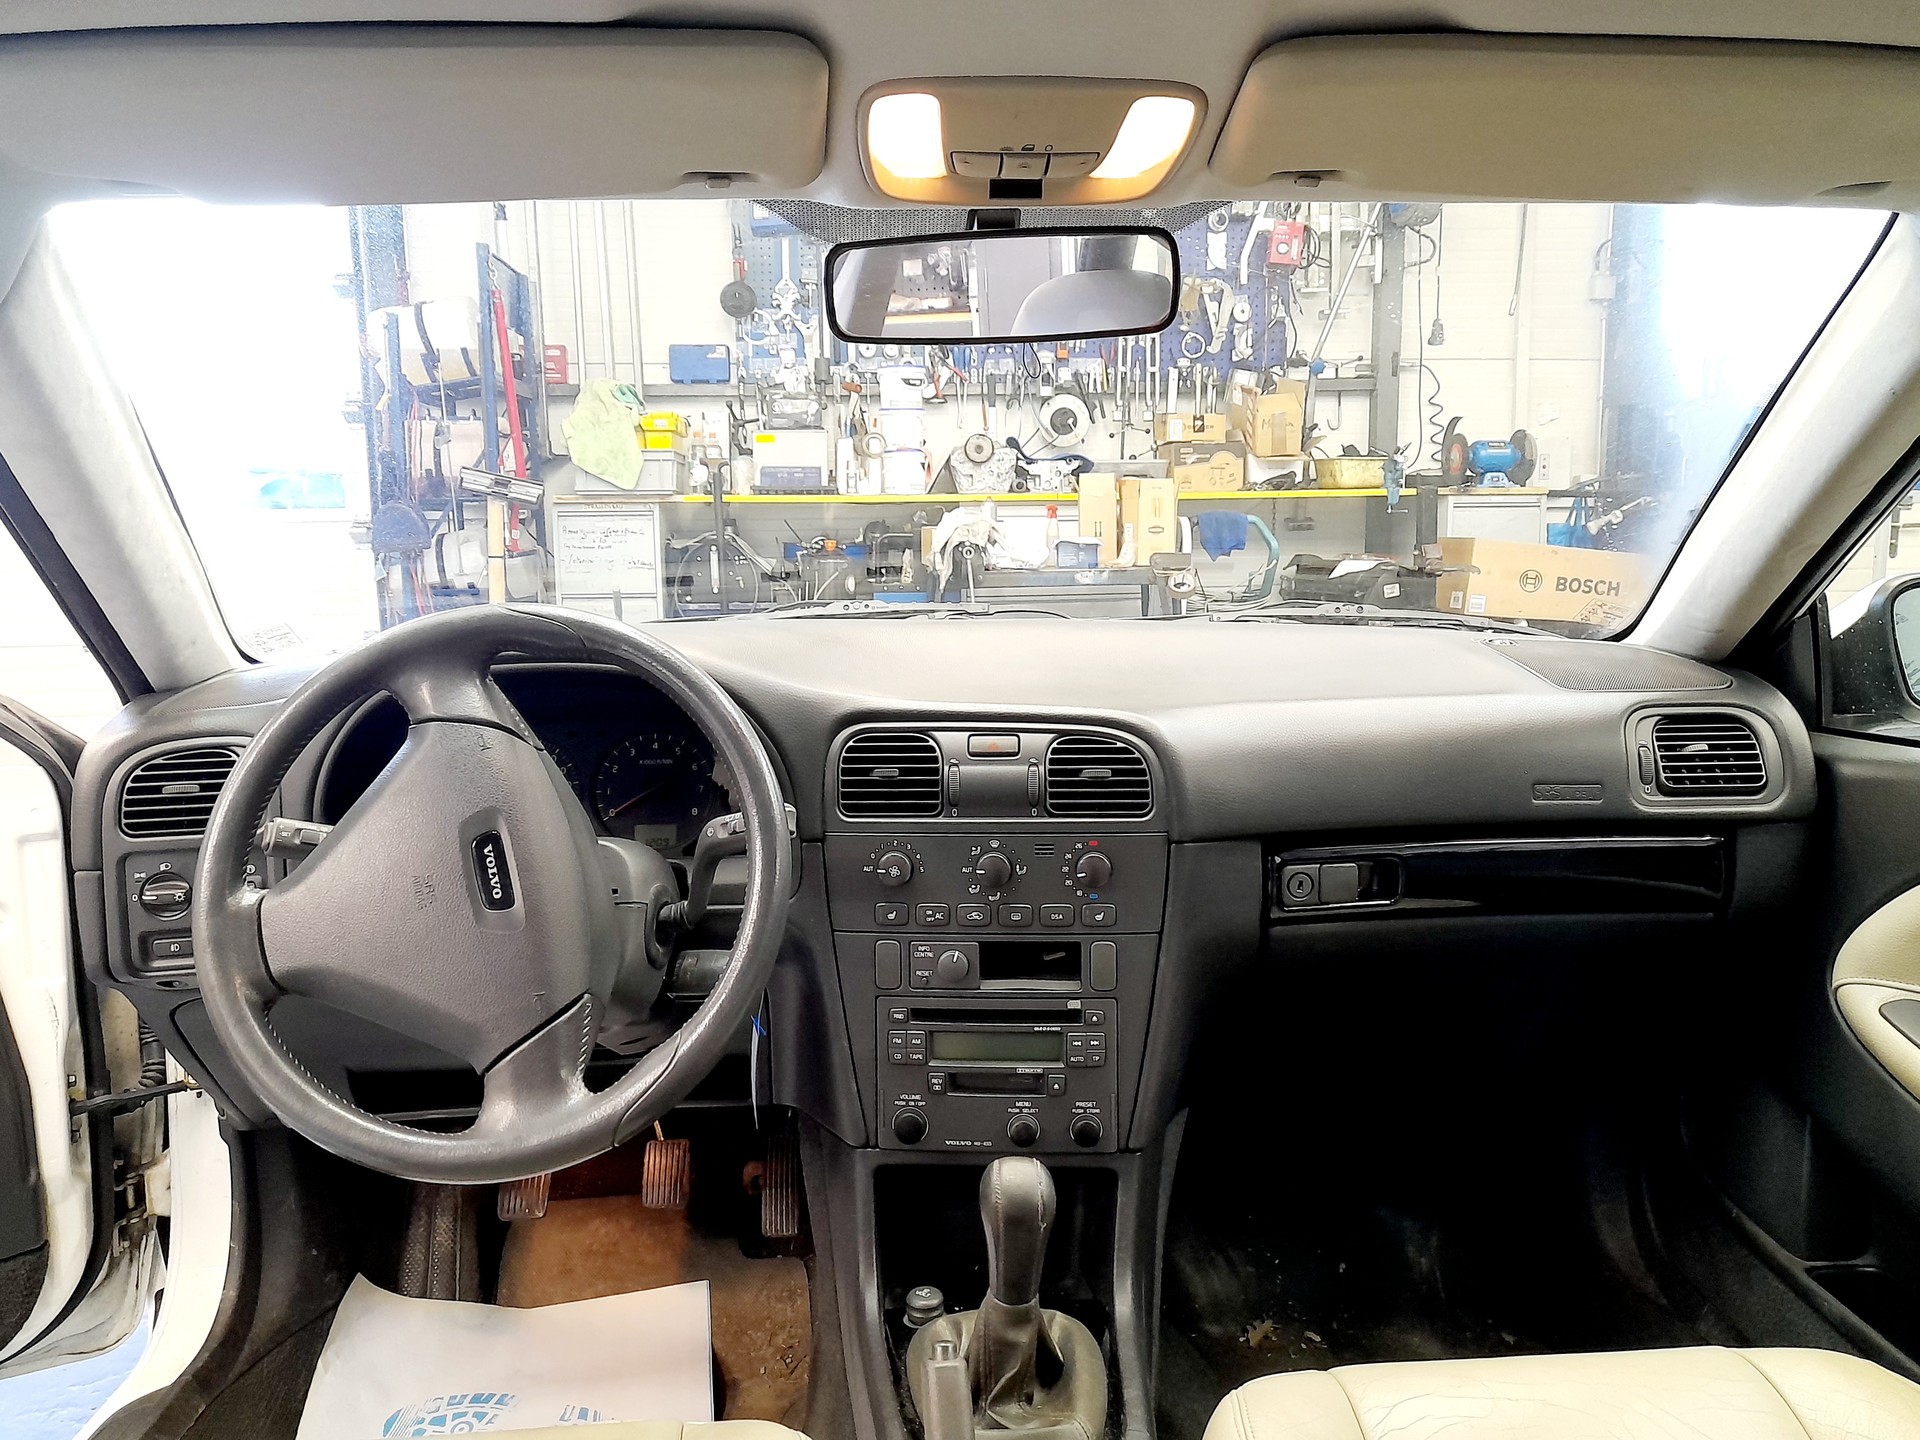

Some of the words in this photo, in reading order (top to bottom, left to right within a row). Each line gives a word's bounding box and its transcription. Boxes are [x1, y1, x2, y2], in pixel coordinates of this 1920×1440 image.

[1555, 576, 1621, 597] BOSCH
[630, 748, 635, 756] 3
[675, 747, 681, 755] 5
[612, 765, 618, 773] 2
[691, 763, 698, 771] 6
[609, 808, 615, 817] 0
[691, 807, 698, 816] 8
[951, 808, 958, 816] 0
[1031, 808, 1038, 816] 0
[483, 843, 502, 899] VOLVO
